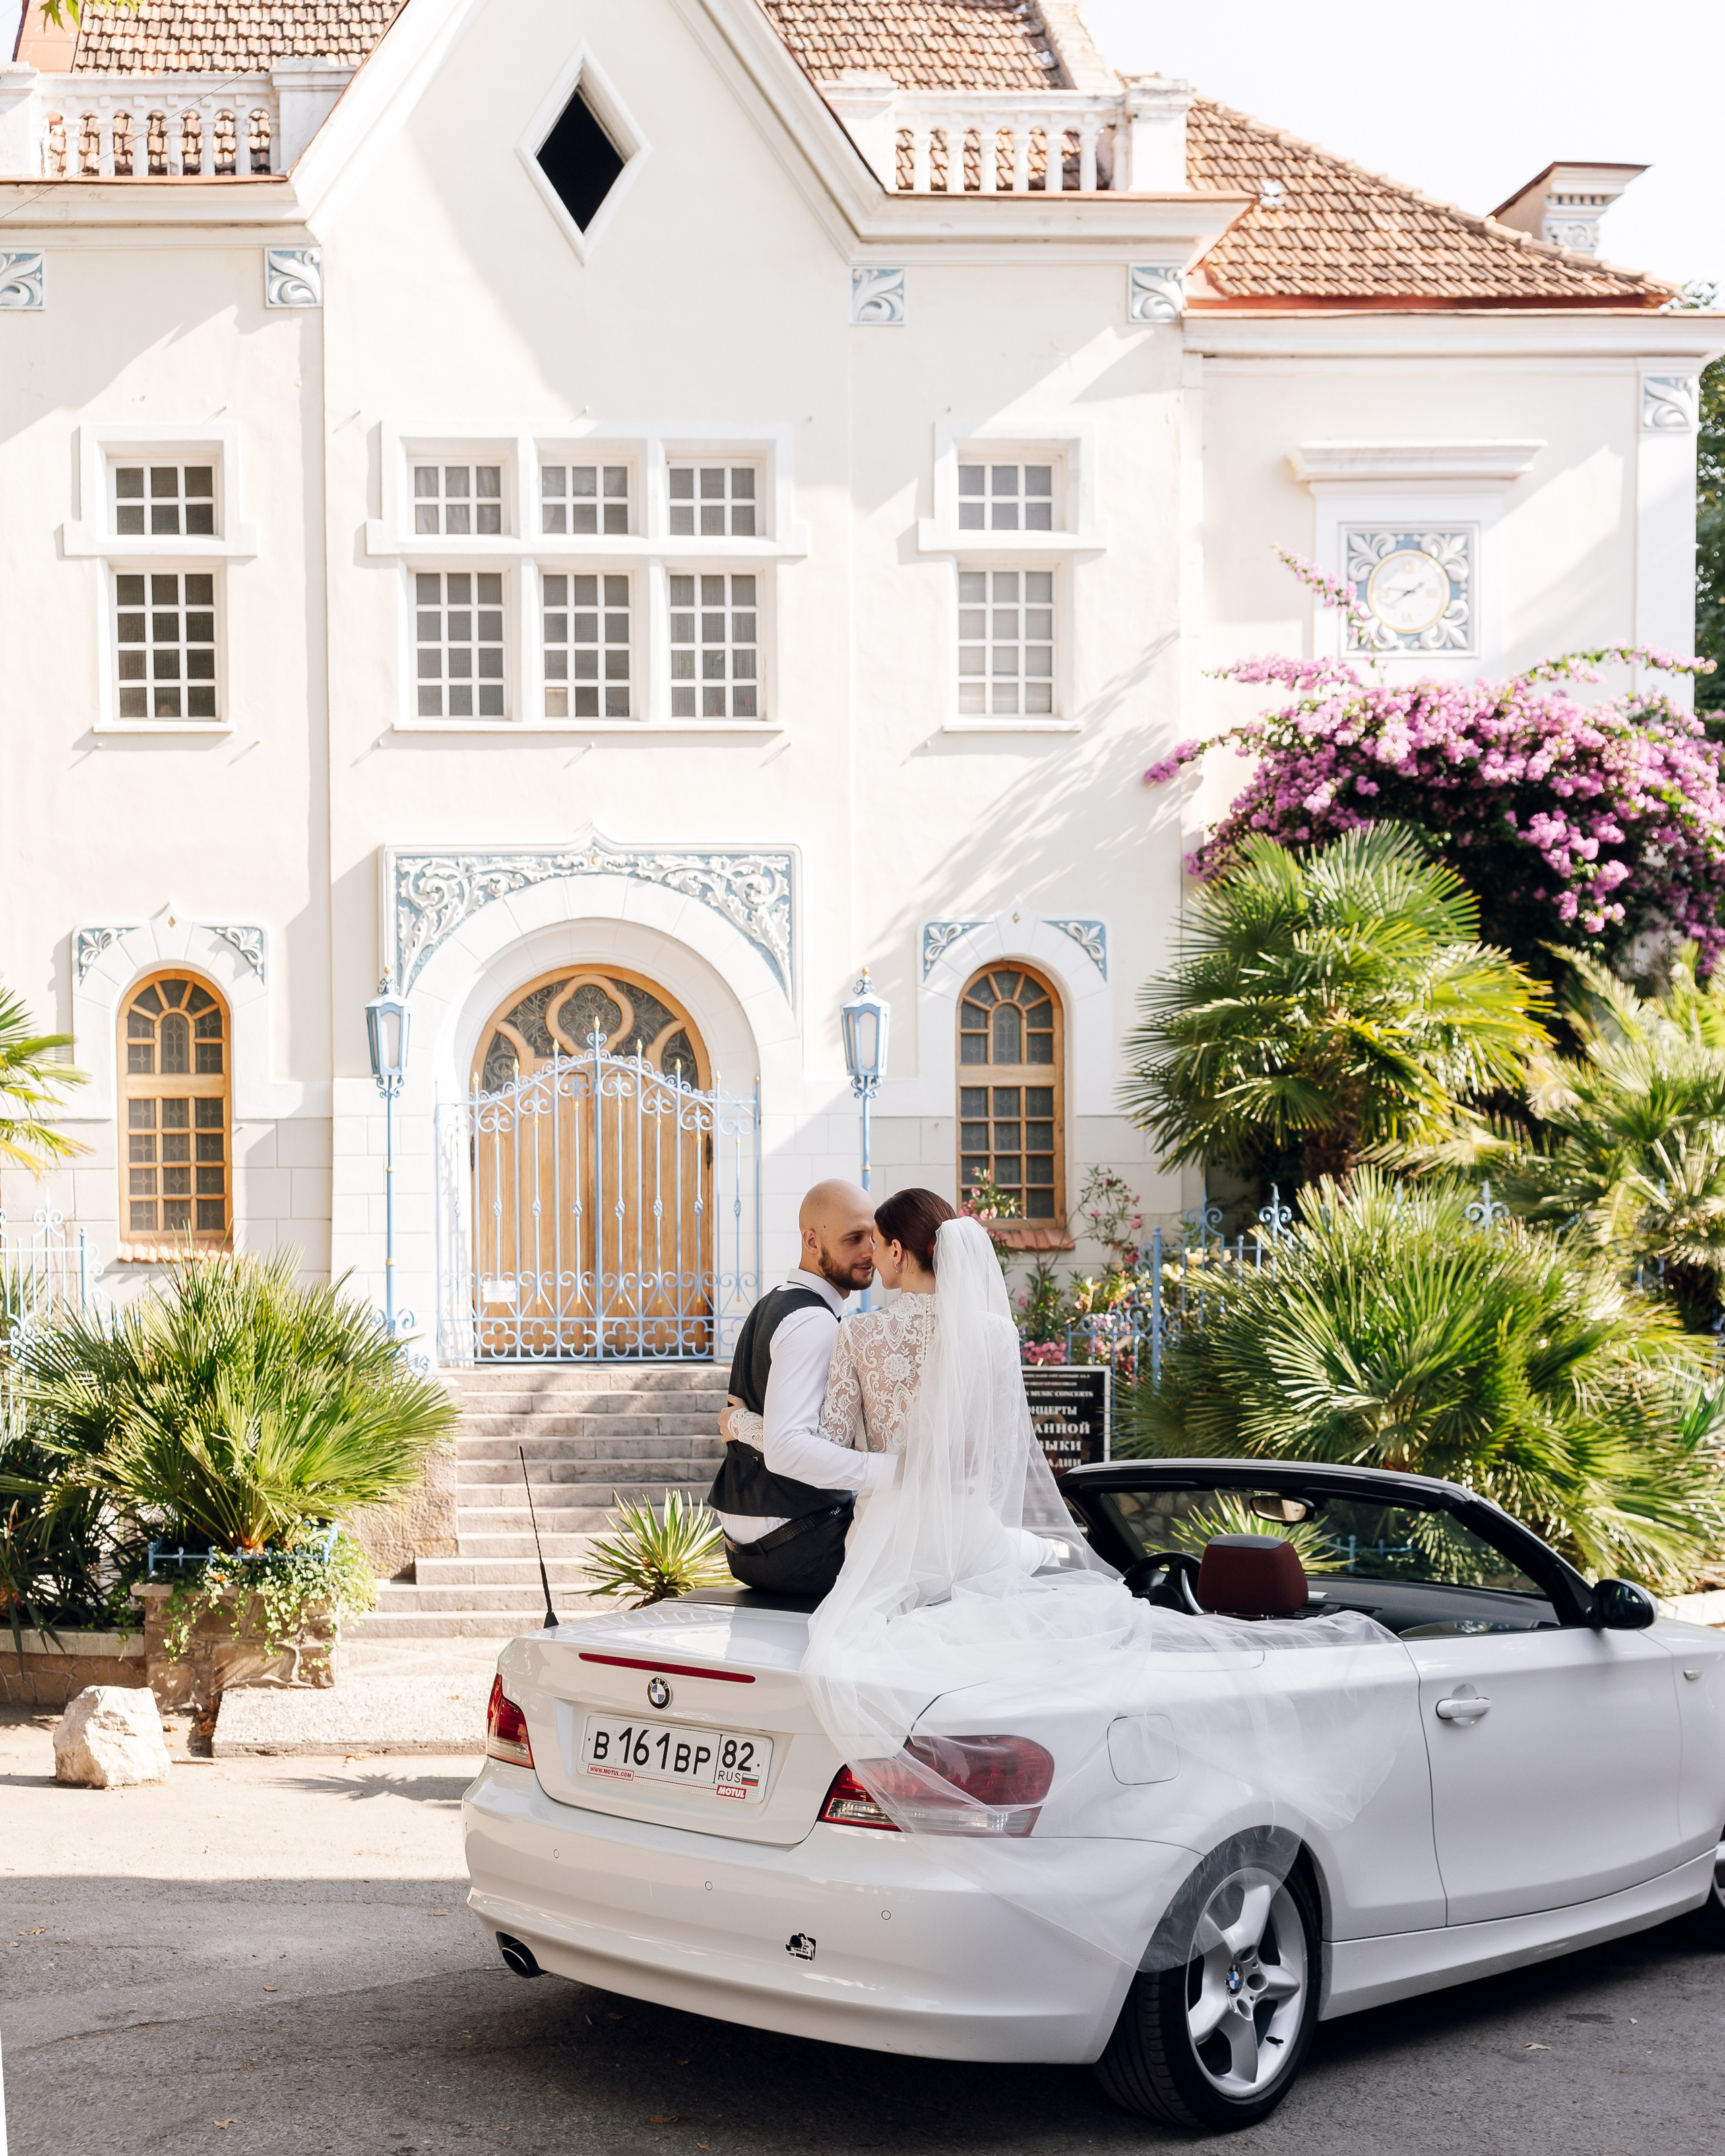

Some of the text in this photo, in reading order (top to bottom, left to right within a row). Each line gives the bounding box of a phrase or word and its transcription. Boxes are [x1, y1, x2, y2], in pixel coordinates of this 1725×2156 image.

[1029, 1406, 1077, 1416] НЦЕРТЫ
[1034, 1422, 1090, 1434] АННОЙ
[1038, 1440, 1081, 1451] ЗЫКИ
[649, 1678, 668, 1689] BMW
[722, 1740, 754, 1772] 82
[590, 1766, 632, 1779] WWW.MOTUL.COM
[718, 1770, 741, 1783] RUS
[718, 1787, 745, 1798] MOTUL
